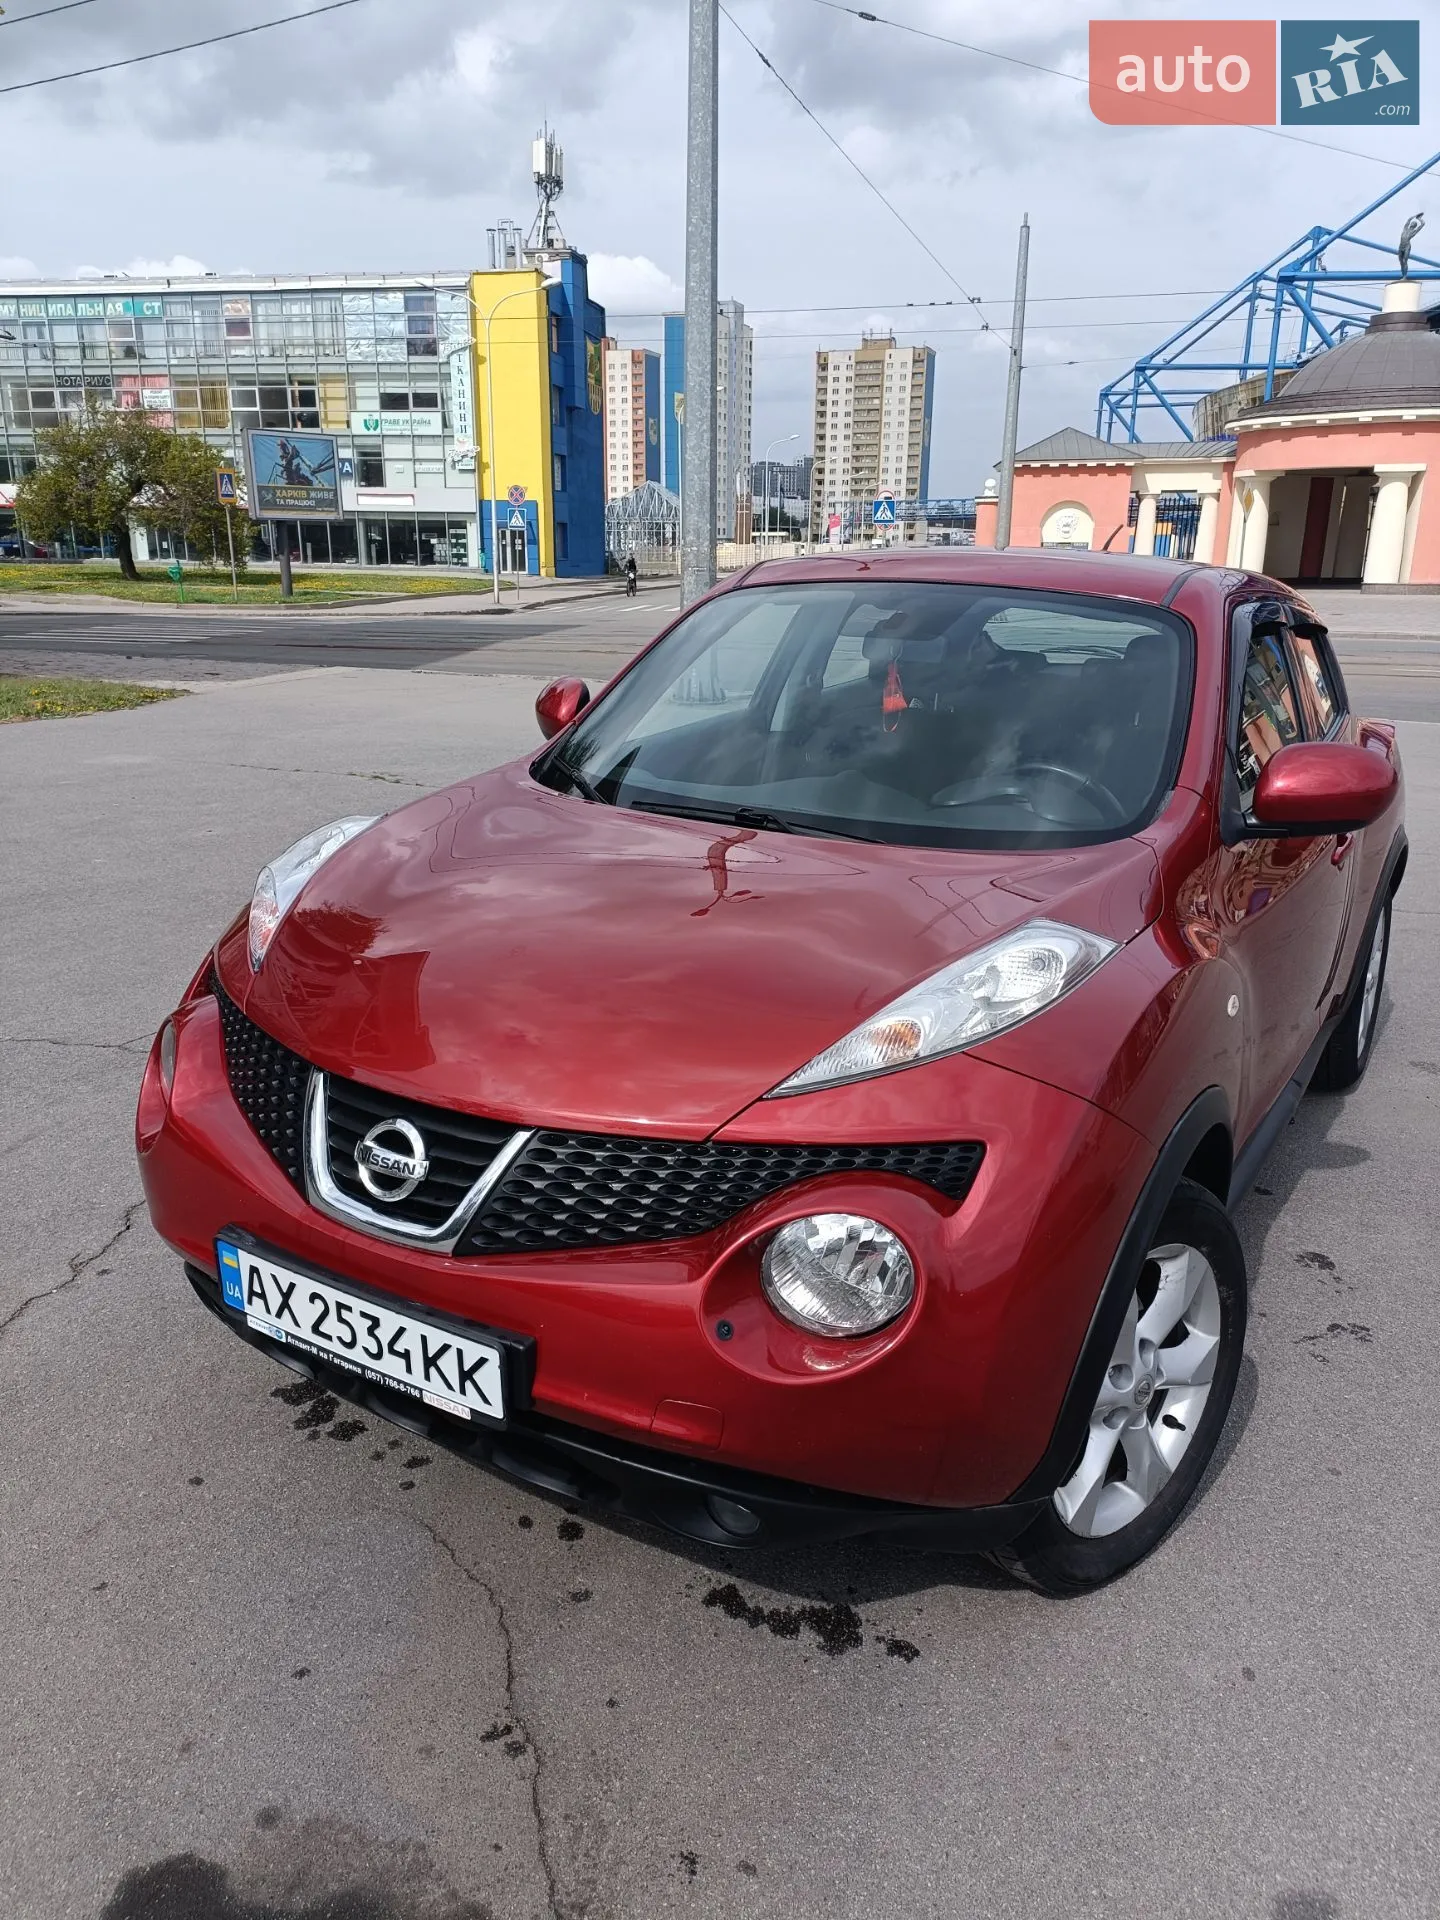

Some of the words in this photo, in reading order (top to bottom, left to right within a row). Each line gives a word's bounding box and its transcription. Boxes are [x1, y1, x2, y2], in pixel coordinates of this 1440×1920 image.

[56, 376, 112, 386] НОТАРИУС
[456, 353, 468, 434] ТКАНИНИ
[275, 489, 307, 498] ХАРКІВ
[309, 490, 335, 499] ЖИВЕ
[358, 1147, 416, 1176] NISSAN
[226, 1281, 242, 1300] UA
[287, 1335, 318, 1355] Атлант-М
[329, 1354, 362, 1374] Гагарина
[365, 1368, 384, 1385] (057)
[423, 1392, 470, 1418] NISSAN
